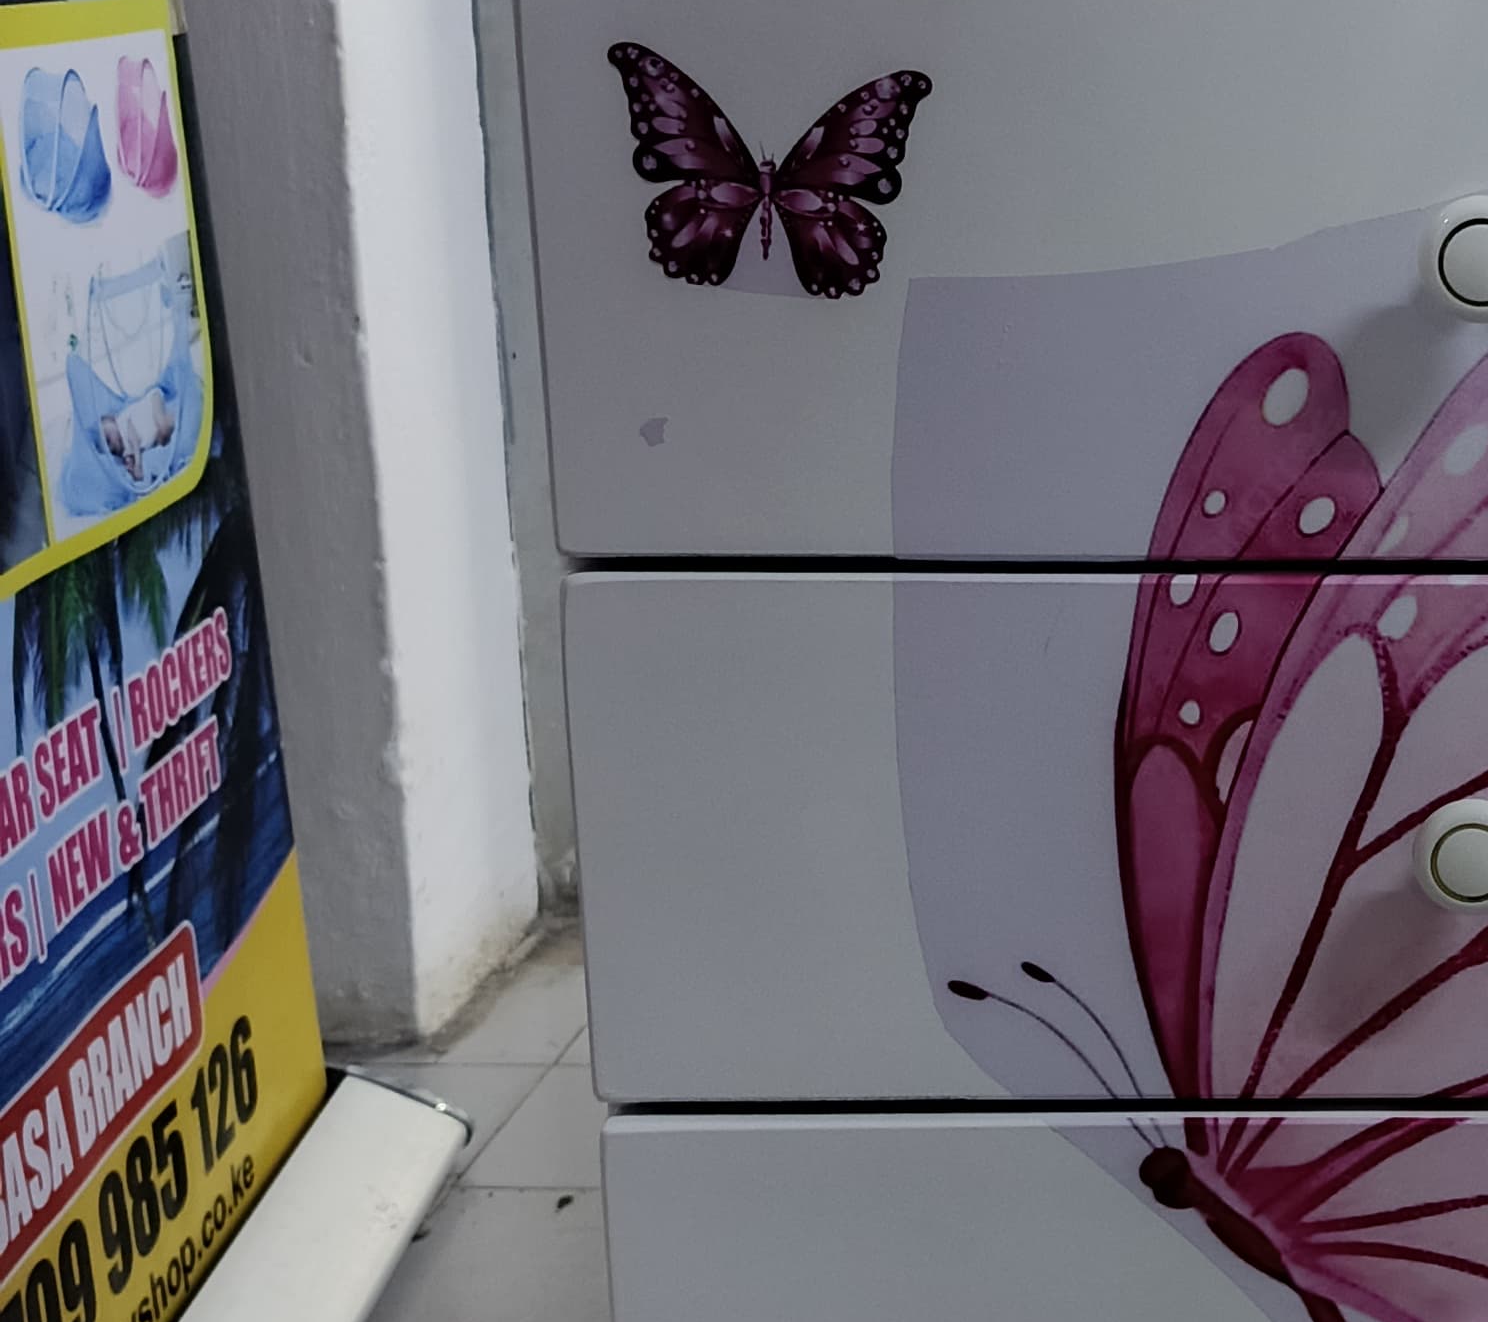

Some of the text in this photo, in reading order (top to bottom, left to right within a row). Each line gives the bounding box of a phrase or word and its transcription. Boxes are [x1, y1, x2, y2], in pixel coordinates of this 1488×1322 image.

[0, 760, 36, 859] AR
[35, 703, 101, 819] SEAT
[127, 610, 232, 750] ROCKERS
[47, 810, 112, 927] NEW
[116, 804, 143, 868] &
[139, 719, 221, 844] THRIFT
[68, 952, 193, 1158] BRANCH
[98, 1099, 189, 1296] 985
[190, 1014, 259, 1176] 126
